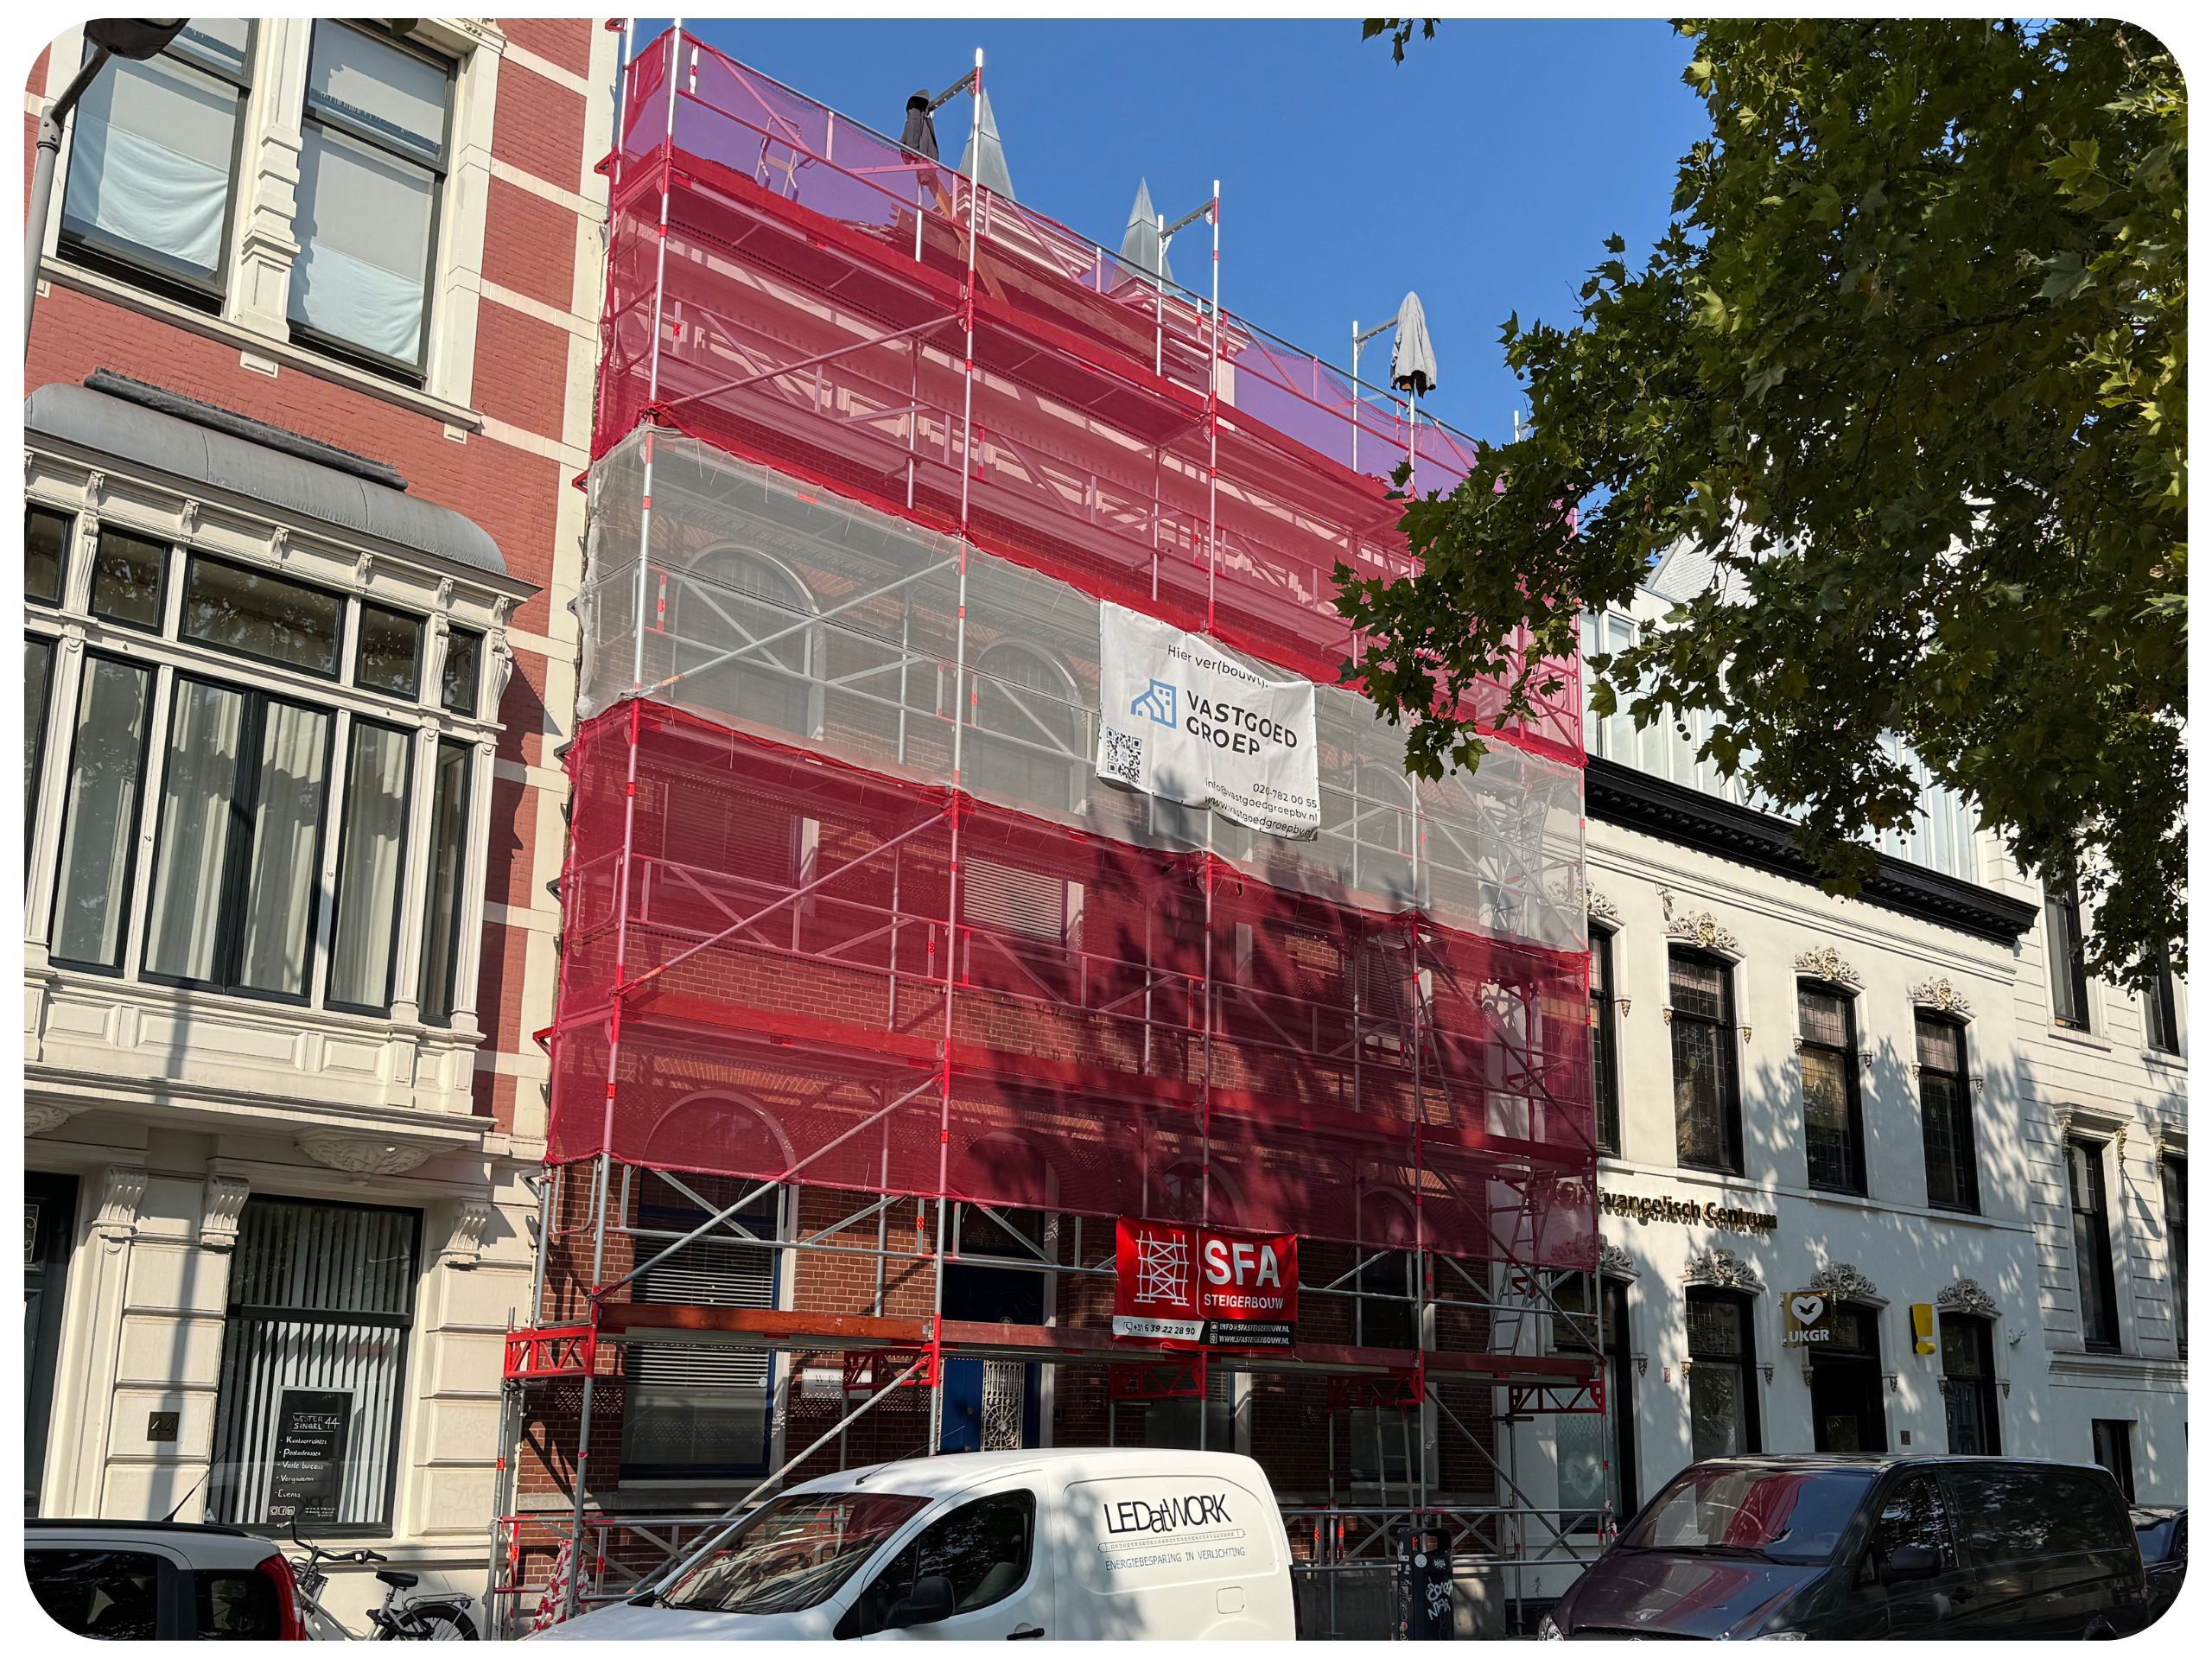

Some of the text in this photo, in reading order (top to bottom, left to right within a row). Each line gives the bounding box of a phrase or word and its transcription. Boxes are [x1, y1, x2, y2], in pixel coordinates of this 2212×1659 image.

[1168, 645, 1192, 662] Hier
[1186, 690, 1298, 748] VASTGOED
[1186, 715, 1261, 756] GROEP
[1205, 778, 1318, 822] info@vastgoedgroepbv.nl
[1253, 783, 1318, 808] 020-782 00 55
[1205, 796, 1313, 836] www.vastgoedgroepbv.nl
[1701, 1202, 1777, 1229] Centrum
[1204, 1239, 1281, 1288] SFA
[1204, 1294, 1284, 1309] STEIGERBOUW
[1162, 1325, 1173, 1334] 22
[1174, 1326, 1184, 1335] 28
[1788, 1329, 1830, 1343] UKGR
[151, 1418, 175, 1435] 44
[324, 1416, 340, 1429] 44
[1103, 1493, 1232, 1534] LEDatWORK
[1105, 1547, 1246, 1571] ENERGIEBESPARING IN VERLICHTING
